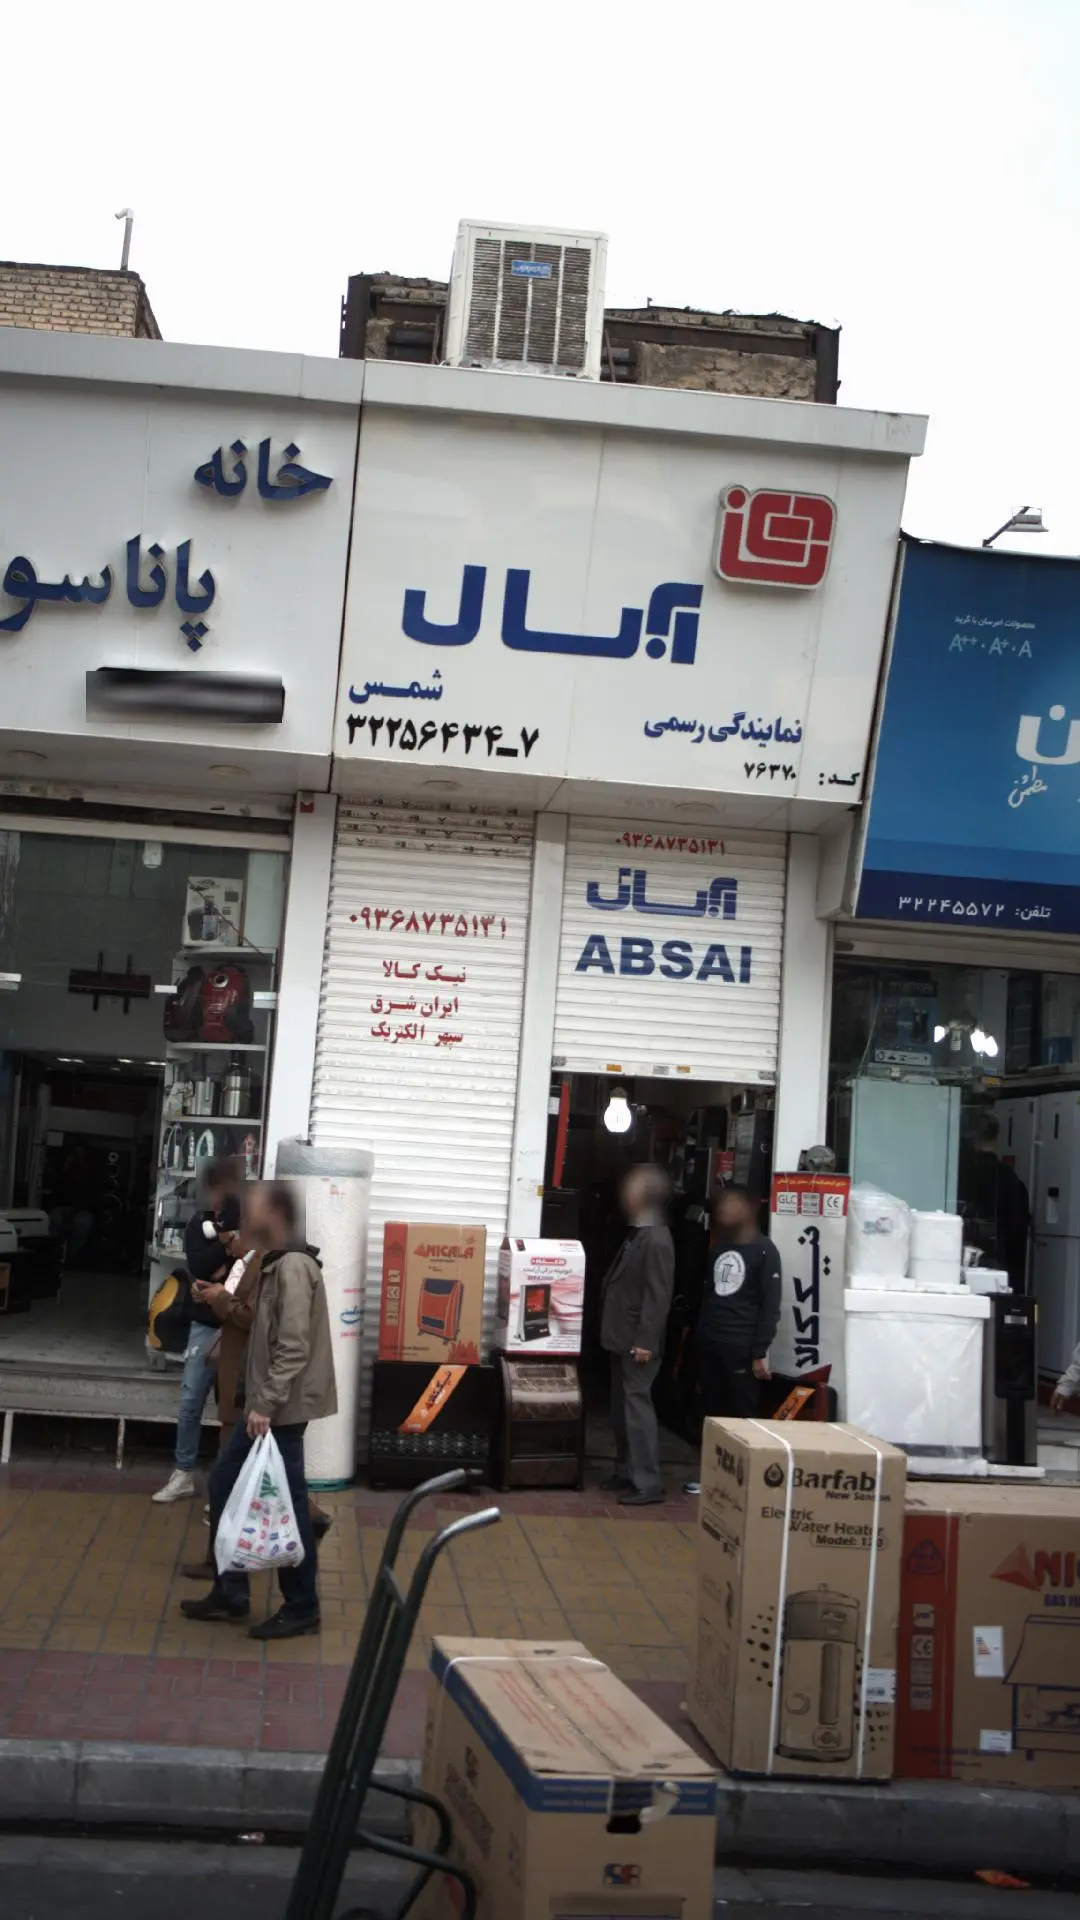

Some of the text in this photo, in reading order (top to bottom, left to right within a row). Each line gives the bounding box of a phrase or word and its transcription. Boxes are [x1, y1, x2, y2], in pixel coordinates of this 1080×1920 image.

[194, 437, 333, 499] خانه
[349, 668, 442, 704] شمس
[643, 711, 802, 748] نمایندگی رسمی
[382, 960, 466, 987] نیک کالا
[371, 994, 459, 1019] ایران شرق
[371, 1021, 425, 1043] الکتریک
[761, 1506, 814, 1521] Eletric
